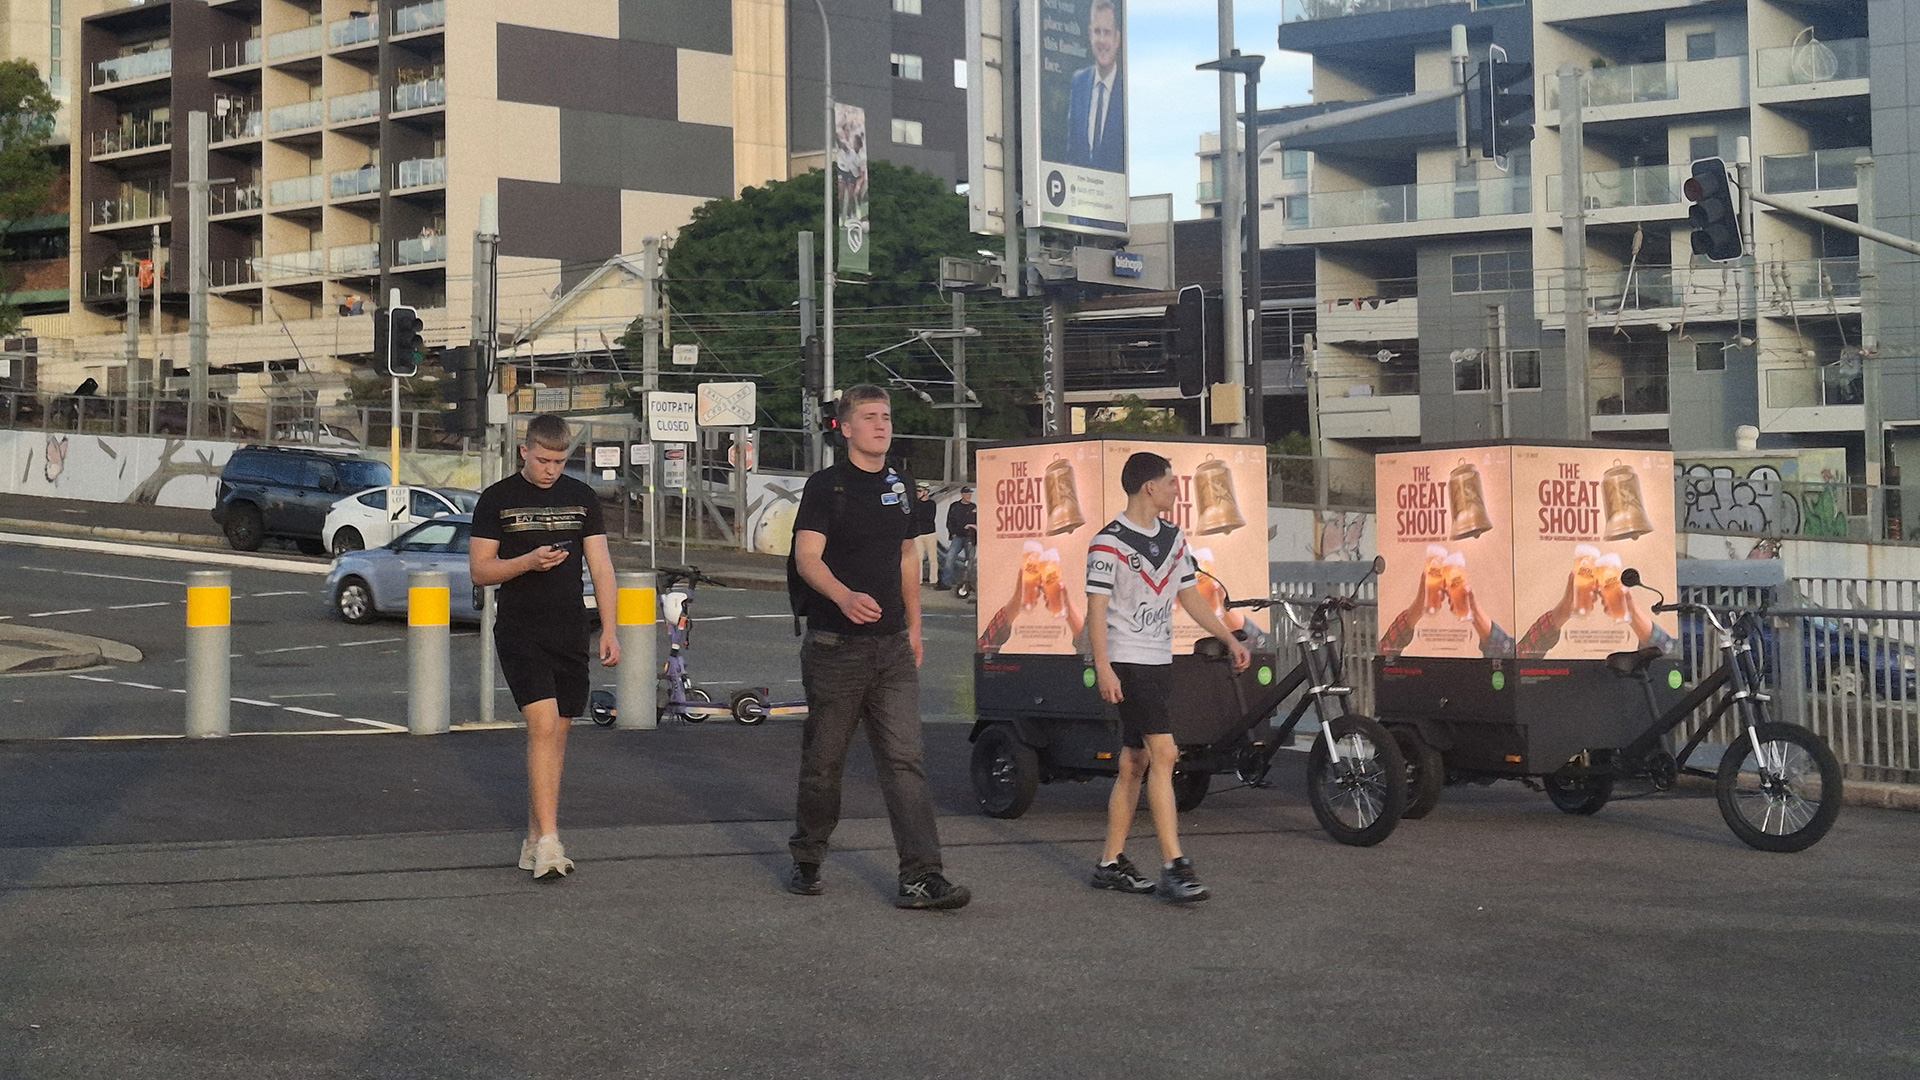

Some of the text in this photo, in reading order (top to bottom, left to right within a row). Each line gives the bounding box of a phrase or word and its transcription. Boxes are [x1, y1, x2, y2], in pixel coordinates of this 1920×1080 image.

[650, 400, 694, 413] FOOTPATH
[656, 420, 690, 432] CLOSED
[1011, 461, 1028, 478] THE
[1412, 466, 1431, 482] THE
[1558, 462, 1581, 480] THE
[996, 477, 1043, 506] GREAT
[1396, 482, 1447, 510] GREAT
[1538, 479, 1600, 508] GREAT
[996, 505, 1043, 532] SHOUT
[1396, 509, 1447, 536] SHOUT
[1538, 507, 1600, 535] SHOUT
